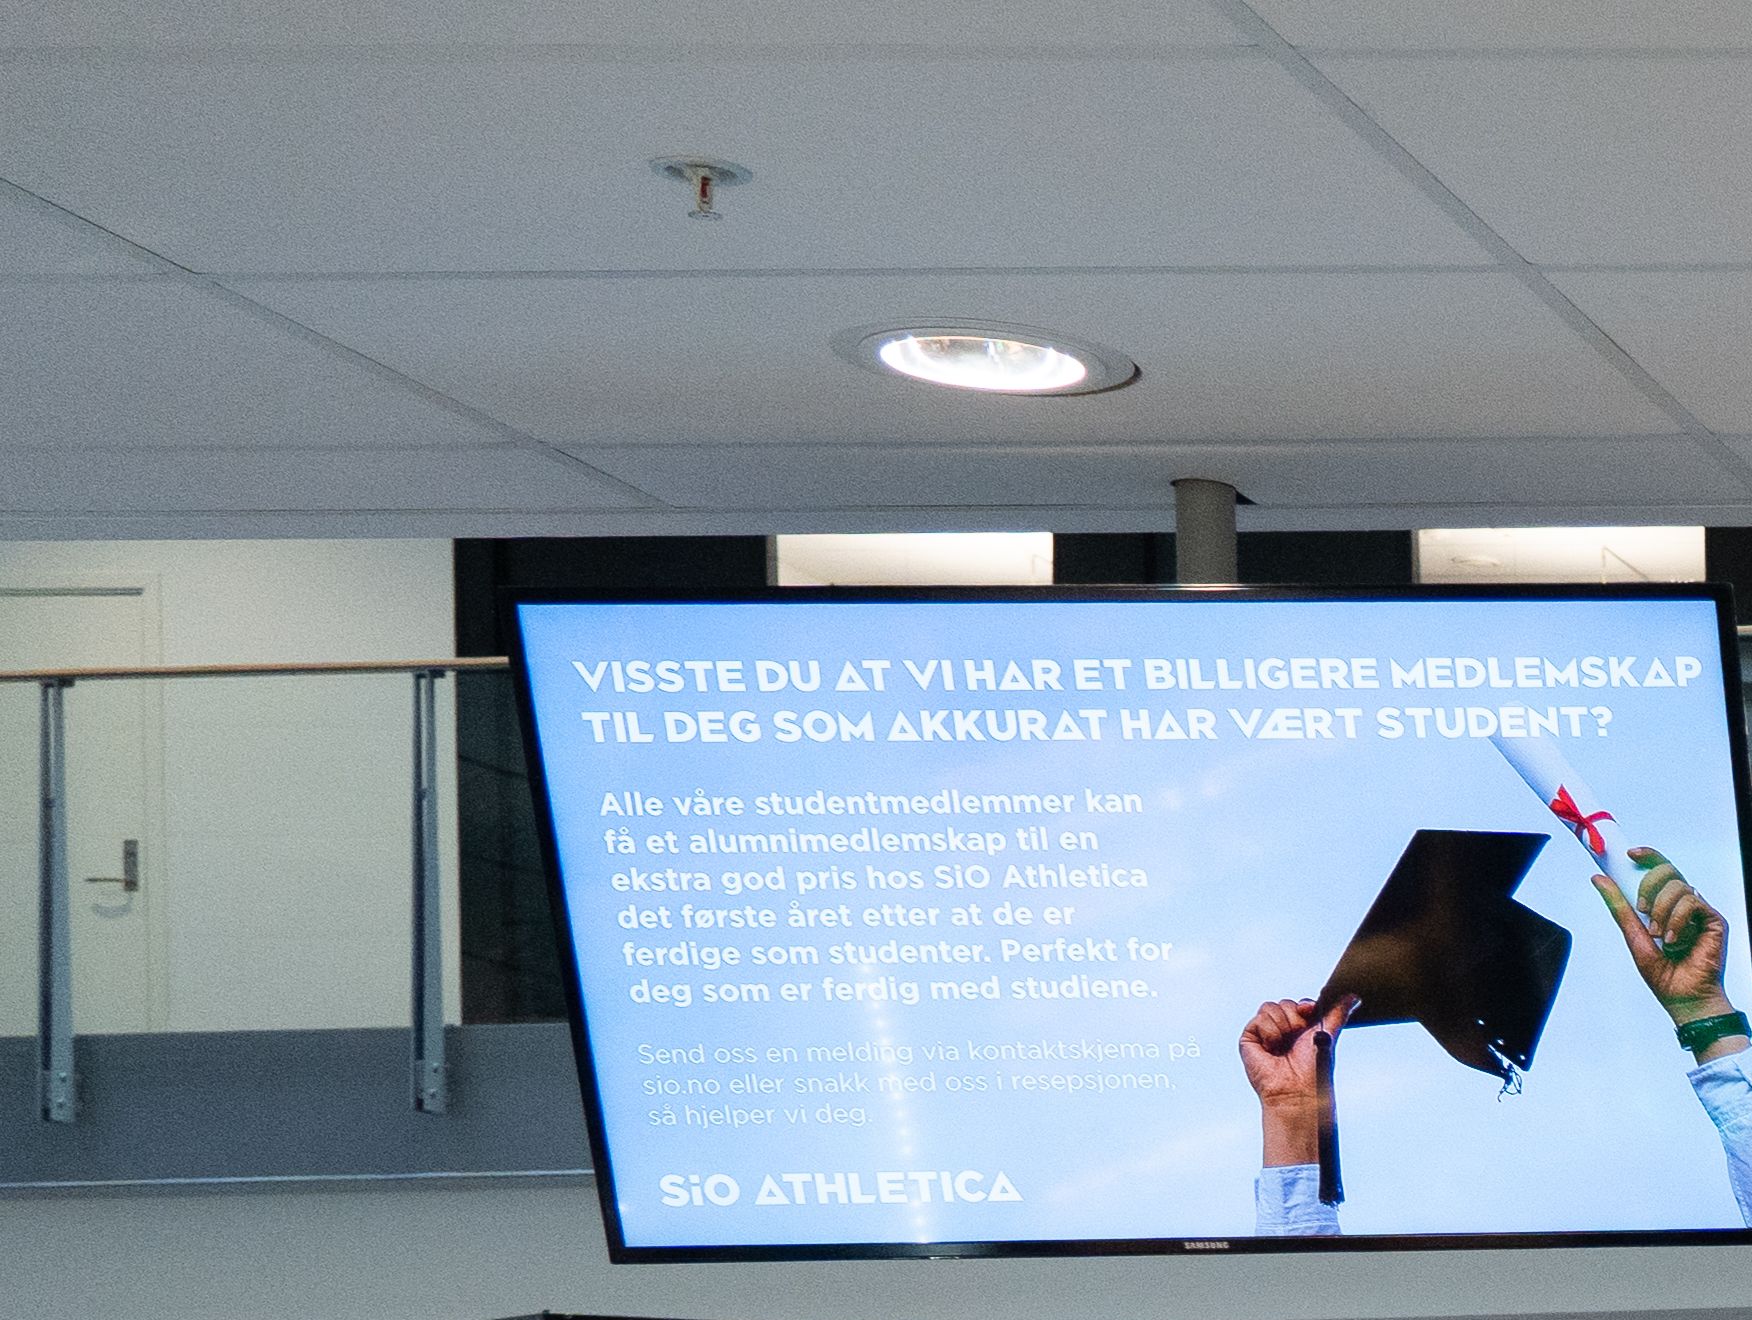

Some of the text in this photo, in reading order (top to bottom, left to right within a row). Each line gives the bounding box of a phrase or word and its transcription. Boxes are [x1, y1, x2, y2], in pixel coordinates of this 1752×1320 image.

[572, 656, 1703, 693] VISSTE DU AT VI HAR ET BILLIGERE MEDLEMSKAP
[581, 705, 1614, 744] TIL DEG SOM AKKURAT HAR VÆRT STUDENT?
[600, 788, 1144, 817] Alle våre studentmedlemmer kan
[604, 826, 1098, 858] få et alumnimedlemskap til en
[611, 863, 1149, 896] ekstra god pris hos SiO Athletica
[617, 900, 1075, 930] det første året etter at de er
[622, 936, 1173, 971] ferdige som studenter. Perfekt for
[629, 974, 1159, 1008] deg som er ferdig med studiene.
[638, 1036, 1202, 1068] Send oss en melding via kontaktskjema på
[642, 1070, 1177, 1098] sio.no eller snakk med oss i resepsjonen,
[648, 1102, 873, 1130] så hjelper vi deg.
[658, 1170, 1024, 1208] SiO ATHLETICA
[1184, 1242, 1230, 1250] SAMSUNG
